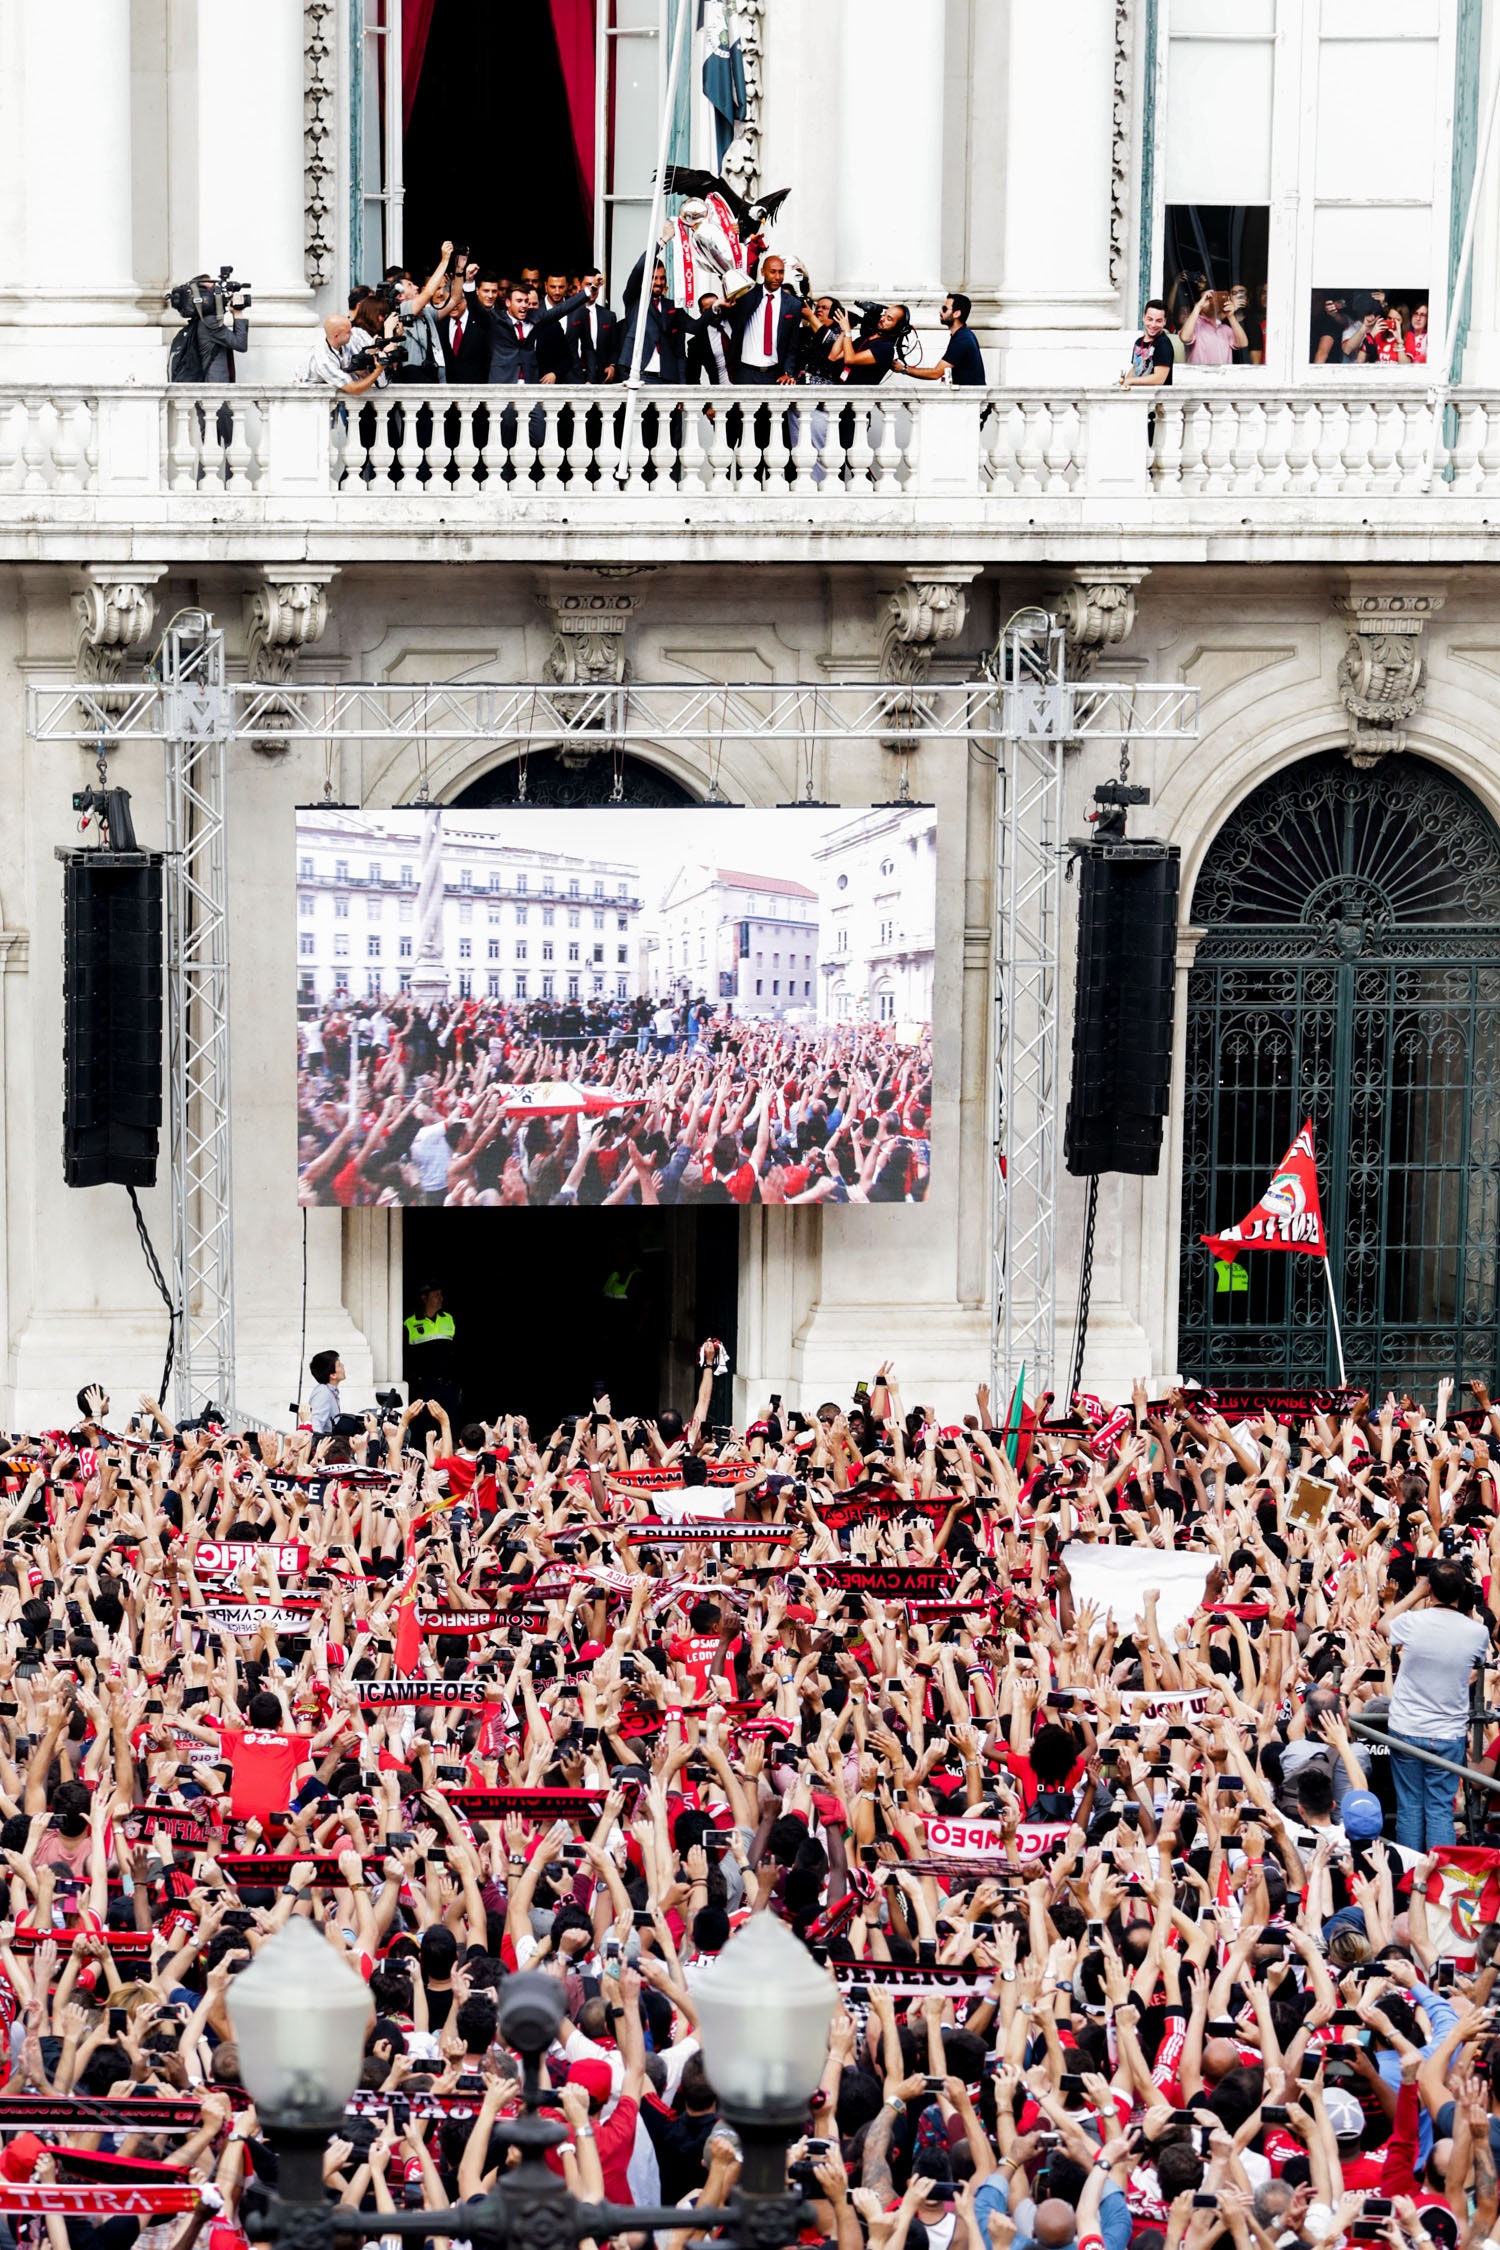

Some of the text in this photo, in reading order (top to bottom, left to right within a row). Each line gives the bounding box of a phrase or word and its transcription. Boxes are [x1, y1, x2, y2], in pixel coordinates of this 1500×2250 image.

[637, 1472, 682, 1486] NAM
[419, 1612, 490, 1627] BENFICA
[6, 2187, 153, 2211] TETRA
